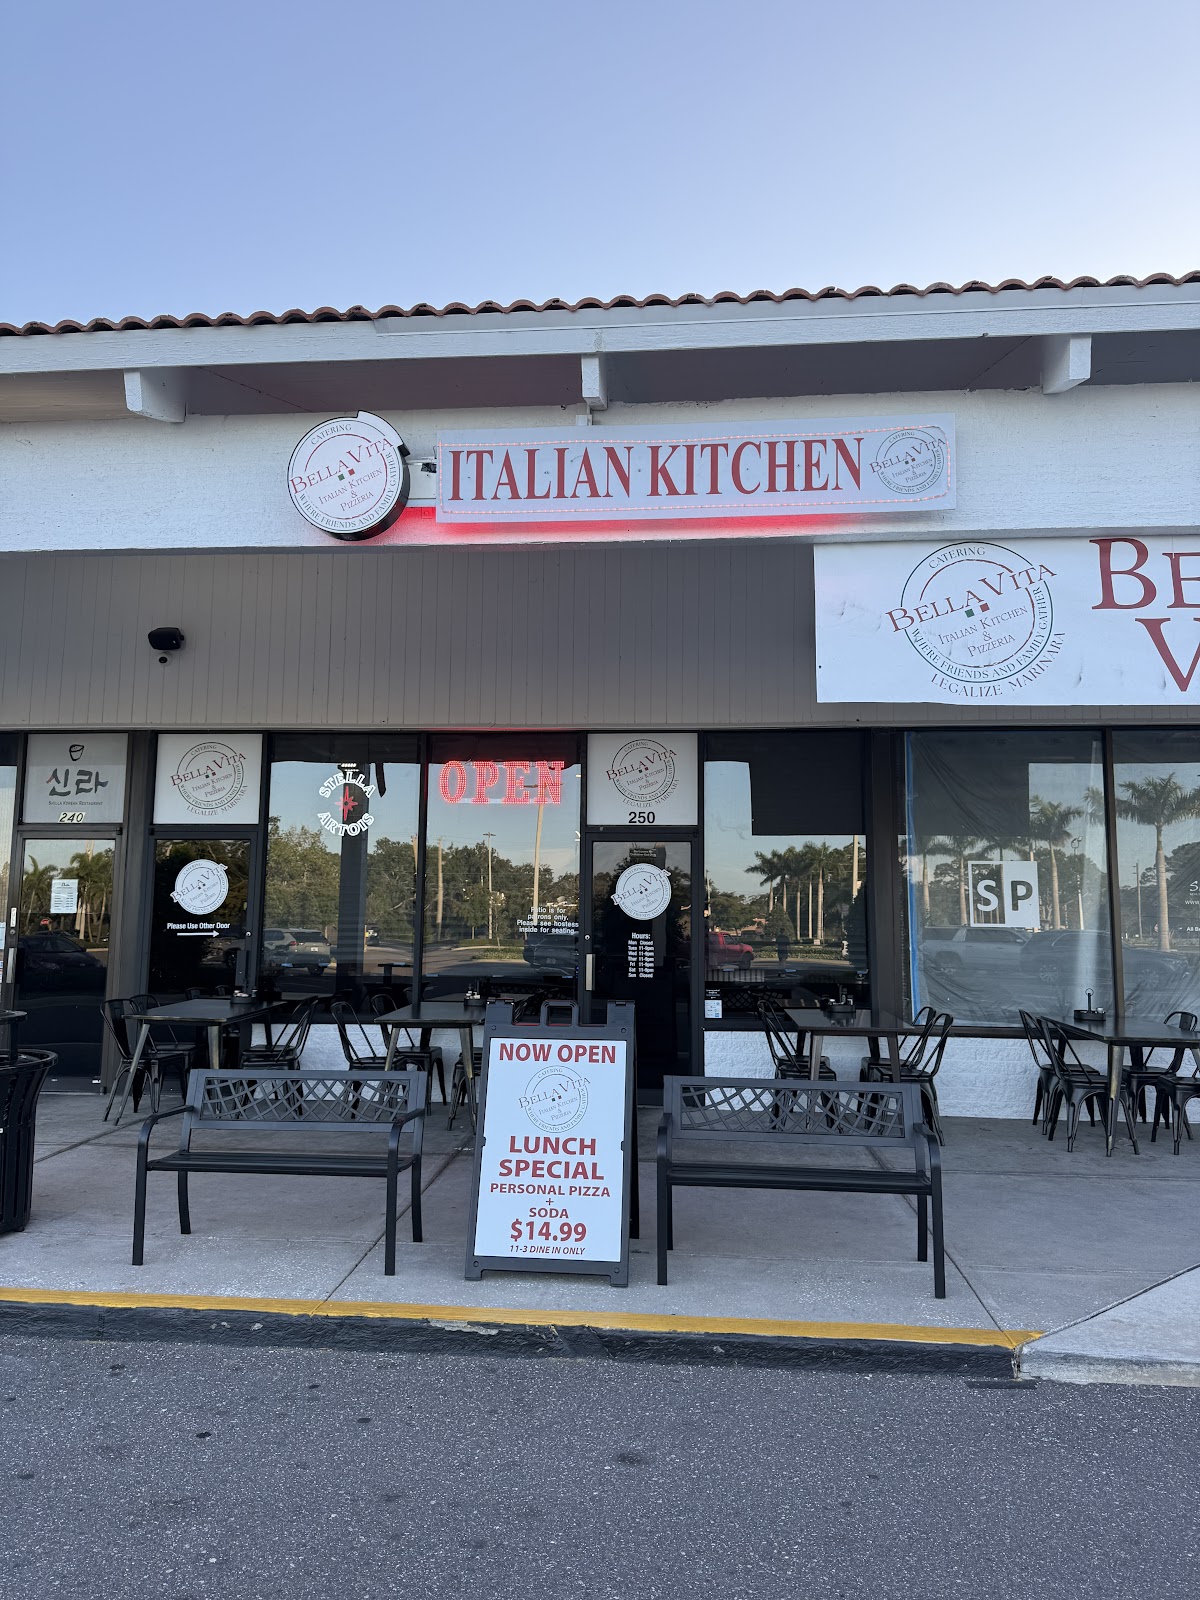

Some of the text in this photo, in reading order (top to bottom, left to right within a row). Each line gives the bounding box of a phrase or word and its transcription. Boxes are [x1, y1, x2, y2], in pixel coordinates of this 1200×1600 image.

[311, 424, 352, 445] CATERING
[290, 438, 394, 494] BELLA VITA
[448, 437, 864, 501] ITALIAN KITCHEN
[318, 468, 382, 504] ITALIAN KITCHEN
[300, 493, 320, 517] WHERE
[321, 517, 356, 528] FRIENDS
[359, 514, 374, 524] AND
[340, 492, 374, 511] PIZZERIA
[929, 547, 986, 569] CATERING
[885, 564, 1057, 632] BELLA VITA
[938, 606, 1028, 644] ITALIAN KITCHEN
[912, 628, 943, 664] WHERE
[940, 662, 989, 679] FRIENDS
[992, 662, 1016, 678] AND
[967, 634, 1016, 657] PIZZERIA
[931, 632, 1066, 697] LEGALIZE MARINARA
[170, 753, 246, 786] BELLA VITA
[46, 768, 108, 796] 신라
[319, 771, 376, 798] STELLA
[439, 760, 564, 804] OPEN
[60, 813, 83, 822] 240
[317, 812, 374, 836] ARTOIS
[628, 811, 655, 823] 250
[499, 1043, 616, 1064] NOW OPEN
[510, 1136, 596, 1156] LUNCH
[499, 1159, 604, 1180] SPECIAL
[490, 1183, 610, 1197] PERSONAL PIZZA
[529, 1208, 569, 1219] SODA
[510, 1218, 587, 1242] $14.99
[510, 1245, 585, 1255] 11-3 DINE IN ONLY
